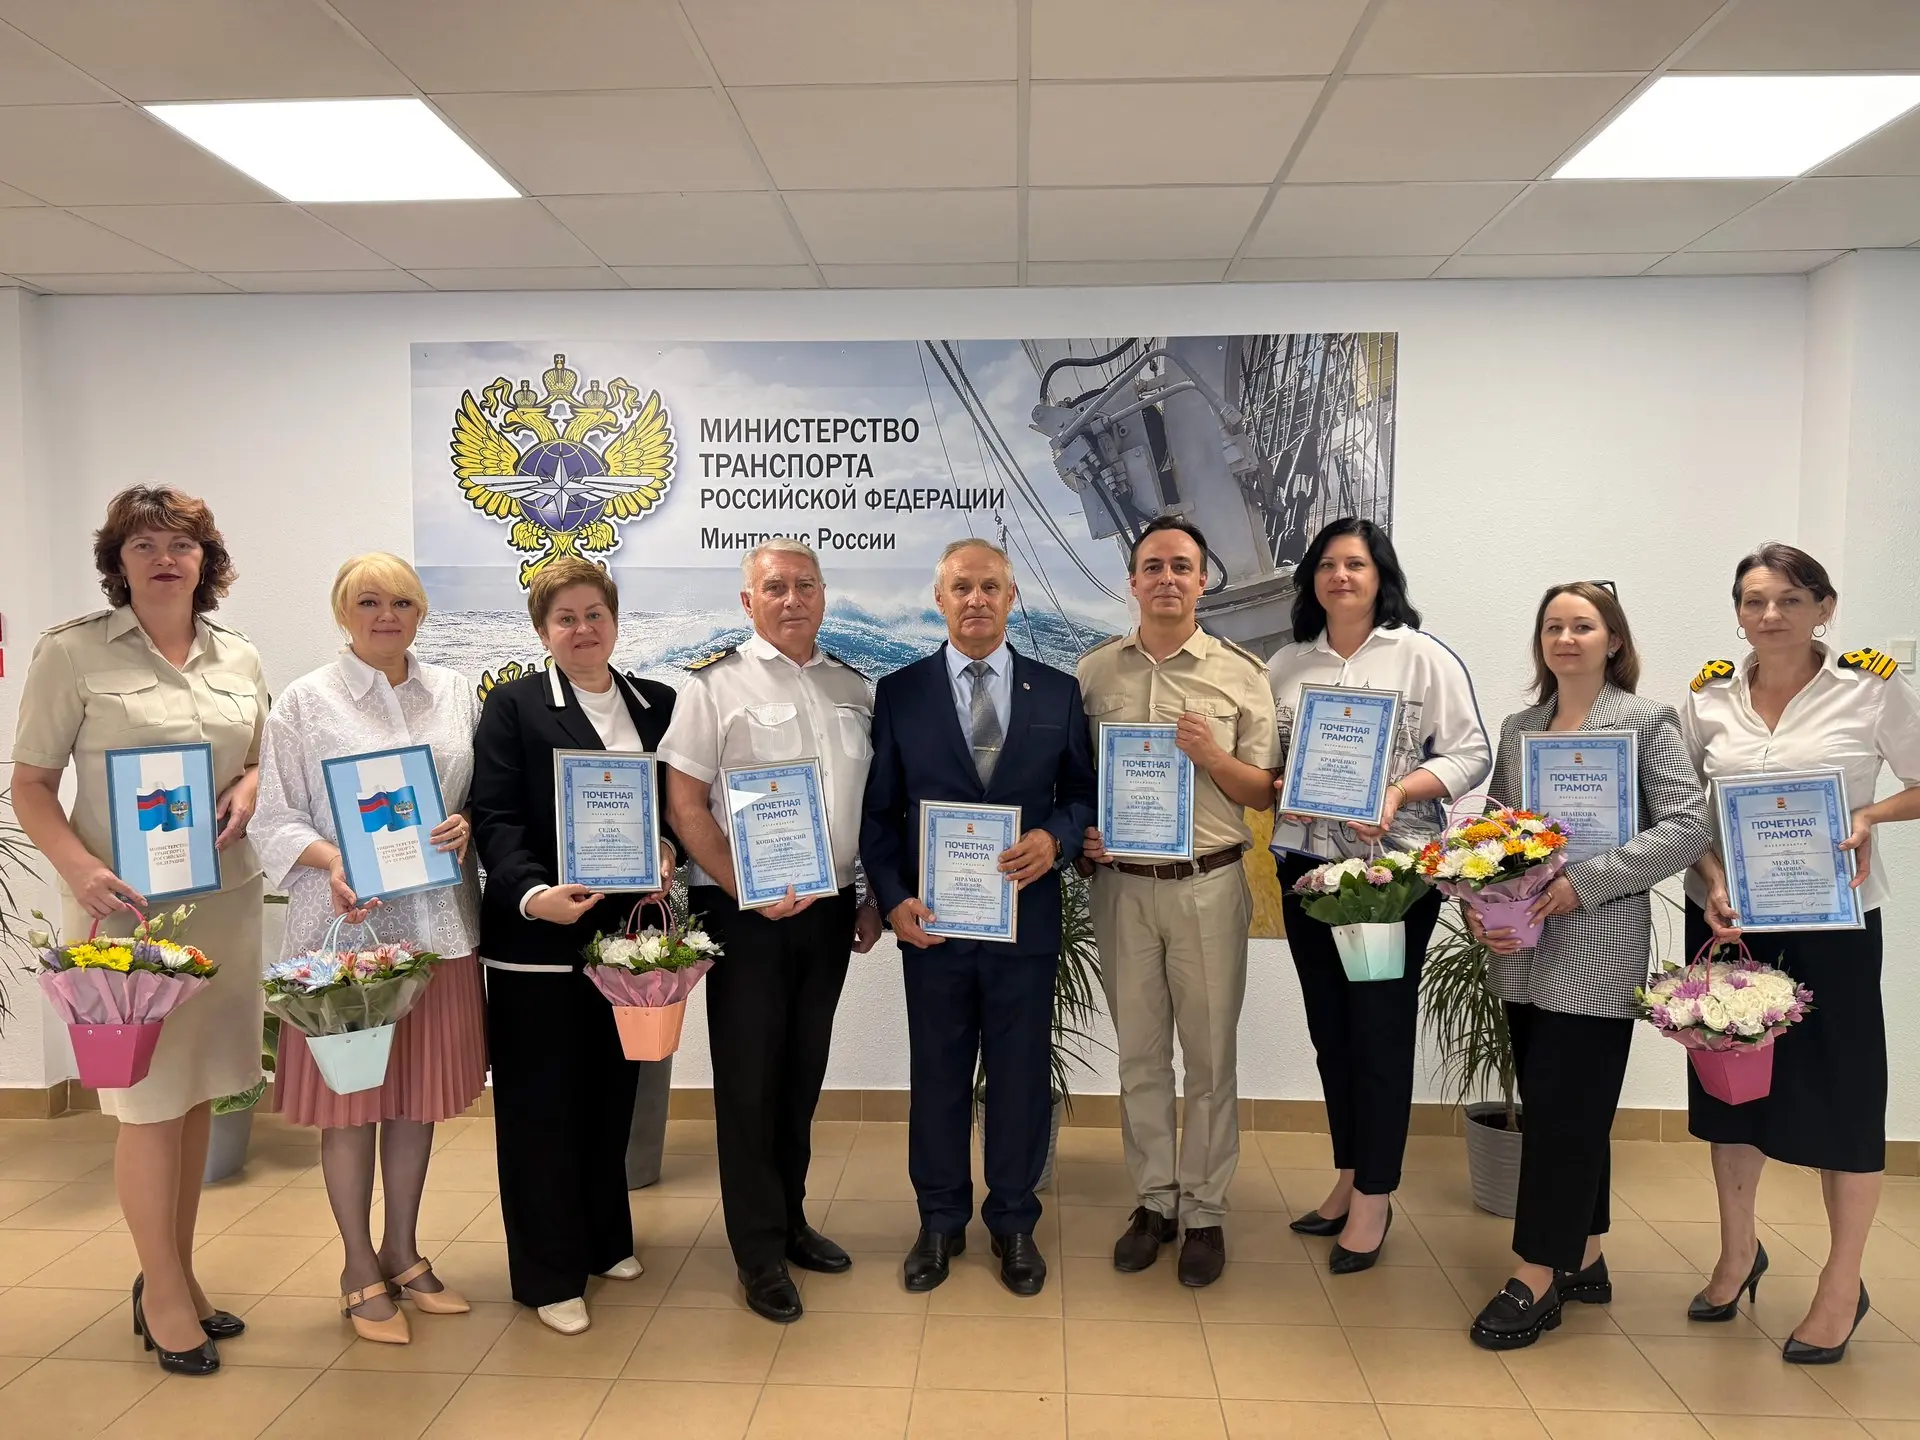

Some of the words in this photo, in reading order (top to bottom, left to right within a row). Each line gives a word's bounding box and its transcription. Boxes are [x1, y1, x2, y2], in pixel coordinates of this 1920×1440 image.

[700, 417, 920, 444] МИНИСТЕРСТВО
[699, 453, 874, 478] ТРАНСПОРТА
[701, 483, 856, 510] РОССИЙСКОЙ
[864, 488, 1004, 514] ФЕДЕРАЦИИ
[701, 528, 810, 550] Минтрс
[818, 528, 896, 550] России
[1319, 723, 1370, 735] ПОЧЕТНАЯ
[1322, 732, 1364, 743] ГРАМОТА
[1122, 760, 1171, 769] ПОЧЕТНАЯ
[1126, 770, 1166, 778] ГРАМОТА
[1550, 773, 1608, 782] ПОЧЕТНАЯ
[582, 790, 634, 800] ПОЧЕТНАЯ
[586, 800, 630, 809] ГРАМОТА
[752, 798, 801, 812] ПОЧЕТНАЯ
[756, 809, 799, 821] ГРАМОТА
[1751, 817, 1816, 830] ПОЧЕТНАЯ
[1757, 829, 1813, 840] ГРАМОТА
[944, 840, 995, 852] ПОЧЕТНАЯ
[948, 850, 990, 860] ГРАМОТА
